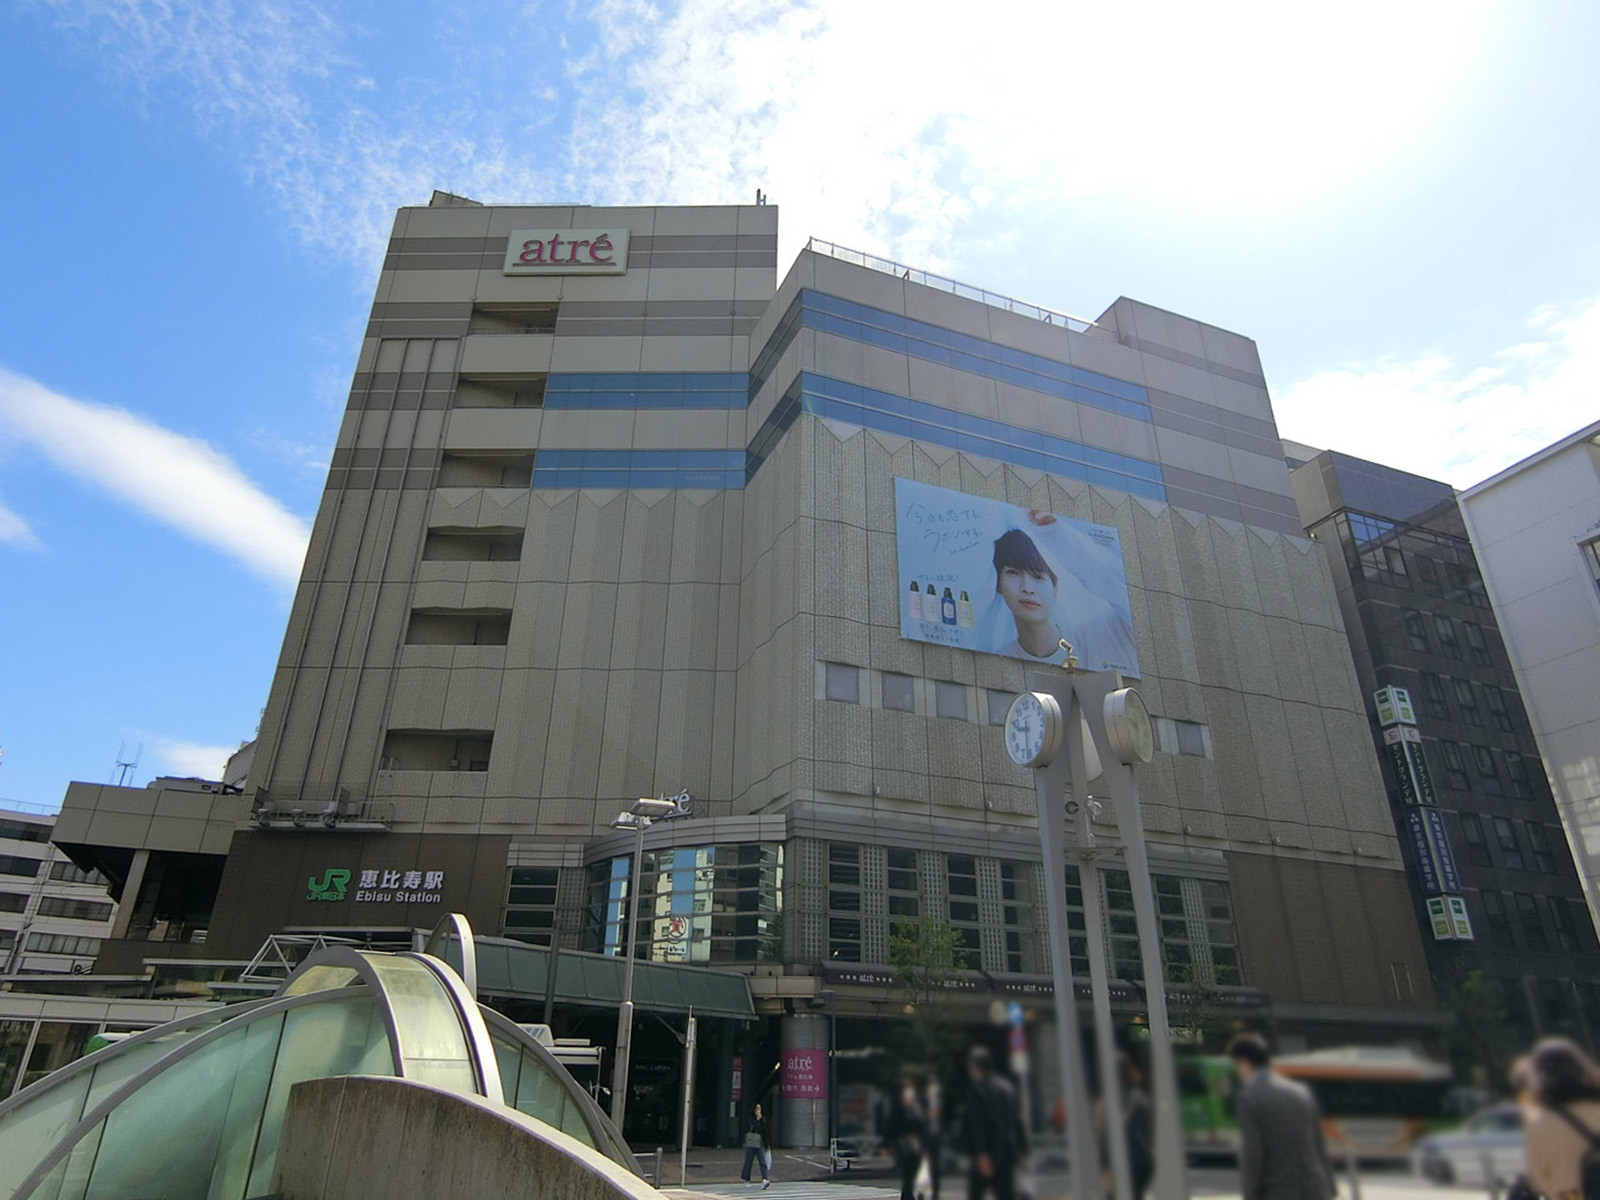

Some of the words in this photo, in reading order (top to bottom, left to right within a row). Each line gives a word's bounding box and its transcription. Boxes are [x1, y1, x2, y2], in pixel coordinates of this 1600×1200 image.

[518, 233, 614, 263] atré
[1021, 700, 1030, 711] 12
[307, 868, 352, 893] JR
[359, 870, 444, 890] 恵比寿駅
[355, 890, 391, 902] Ebisu
[395, 891, 441, 903] Station
[787, 1056, 813, 1070] atré
